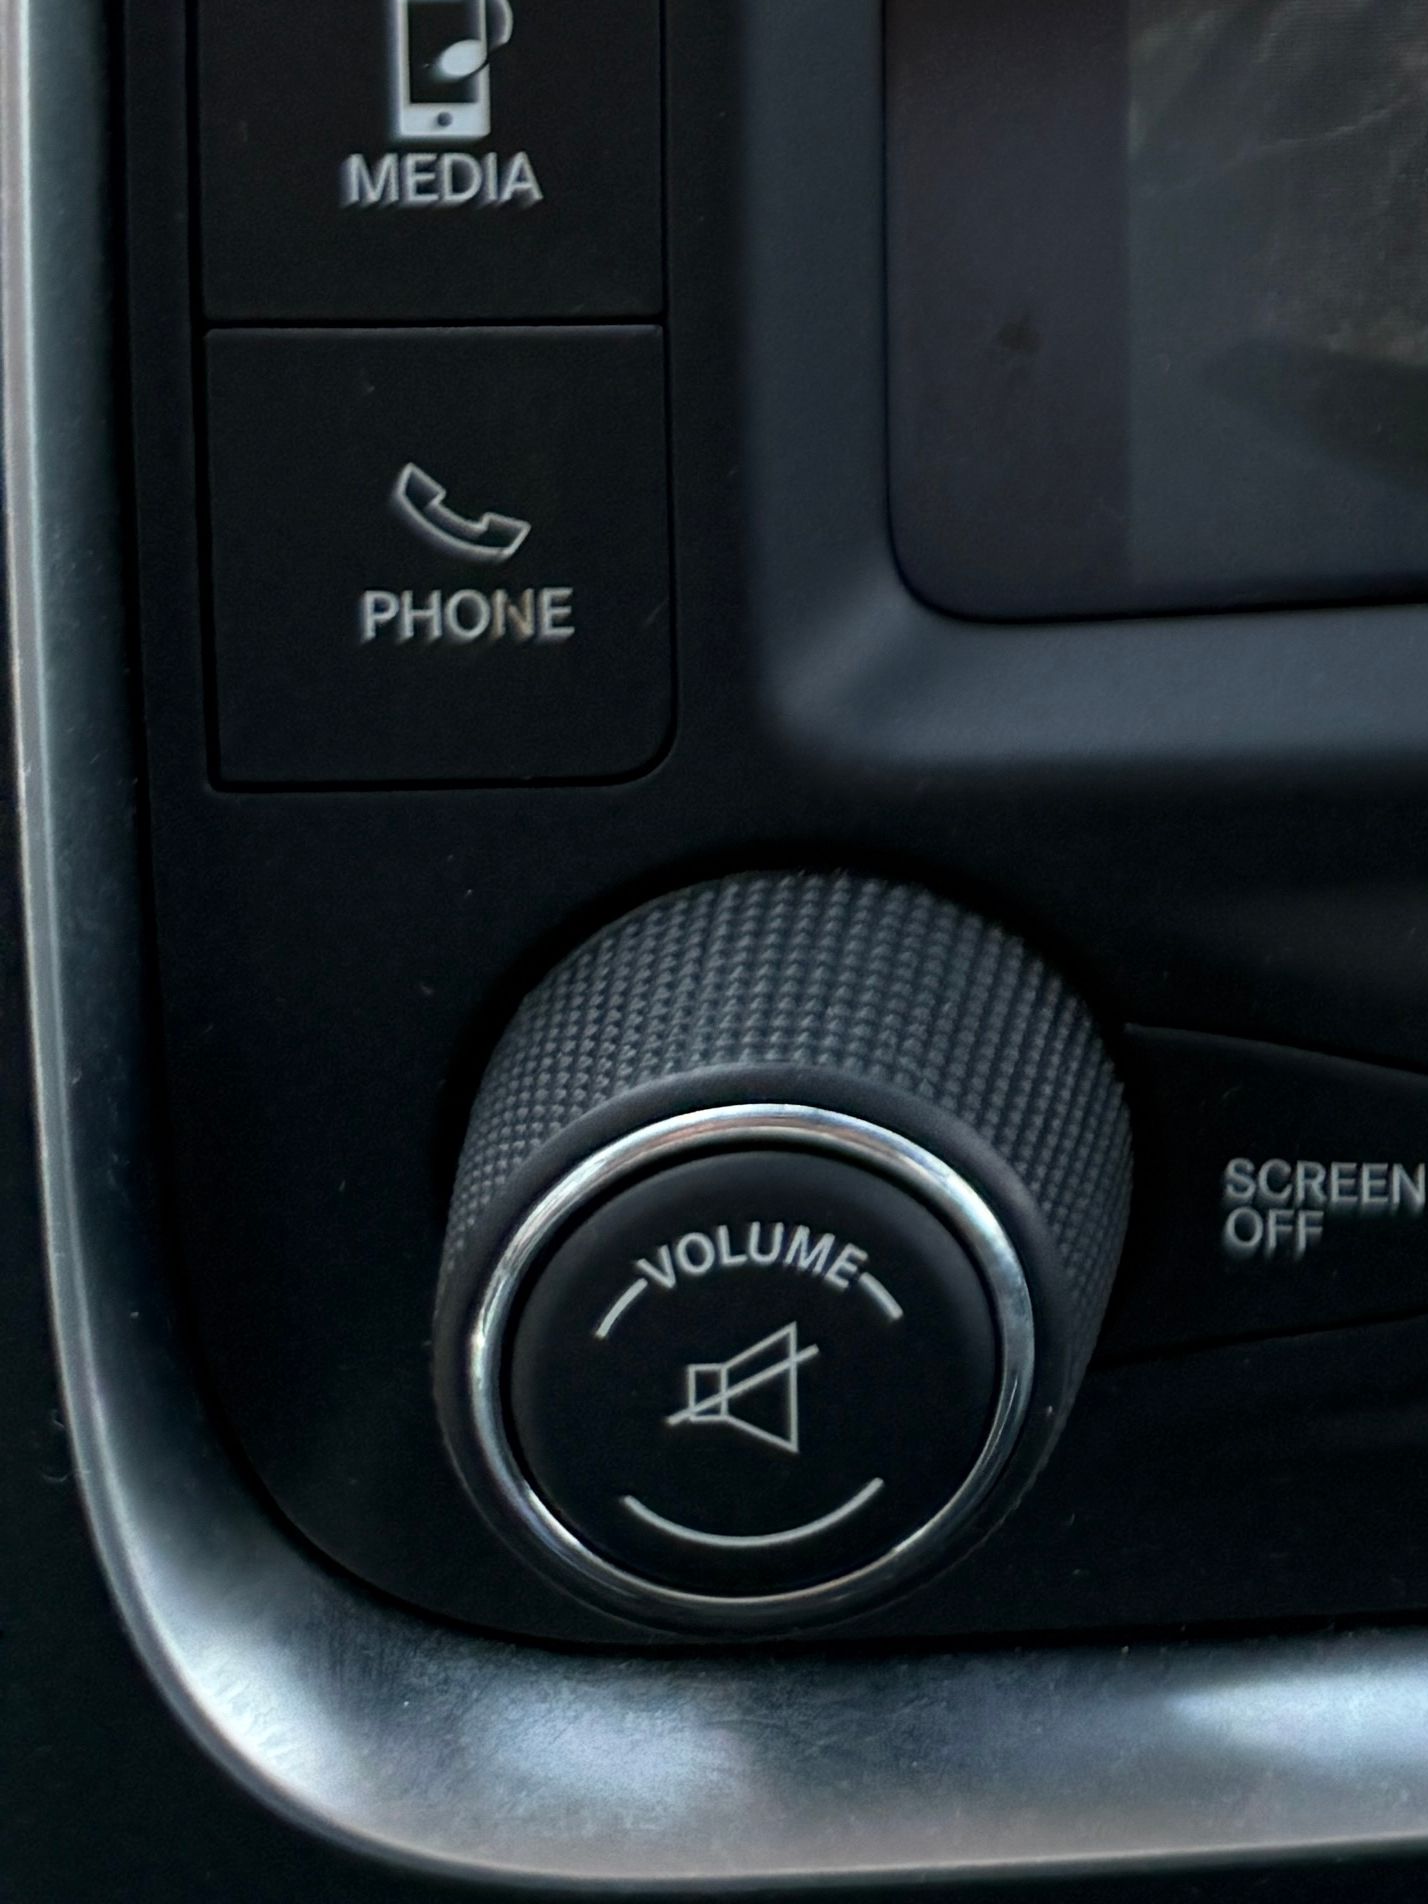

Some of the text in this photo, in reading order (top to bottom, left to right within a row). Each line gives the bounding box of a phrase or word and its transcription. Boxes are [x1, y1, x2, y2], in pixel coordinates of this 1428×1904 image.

[345, 150, 543, 205] MEDIA
[361, 587, 575, 641] PHONE
[1225, 1158, 1427, 1206] SCREEN
[635, 1221, 869, 1293] VOLUME
[1225, 1206, 1324, 1254] OFF
